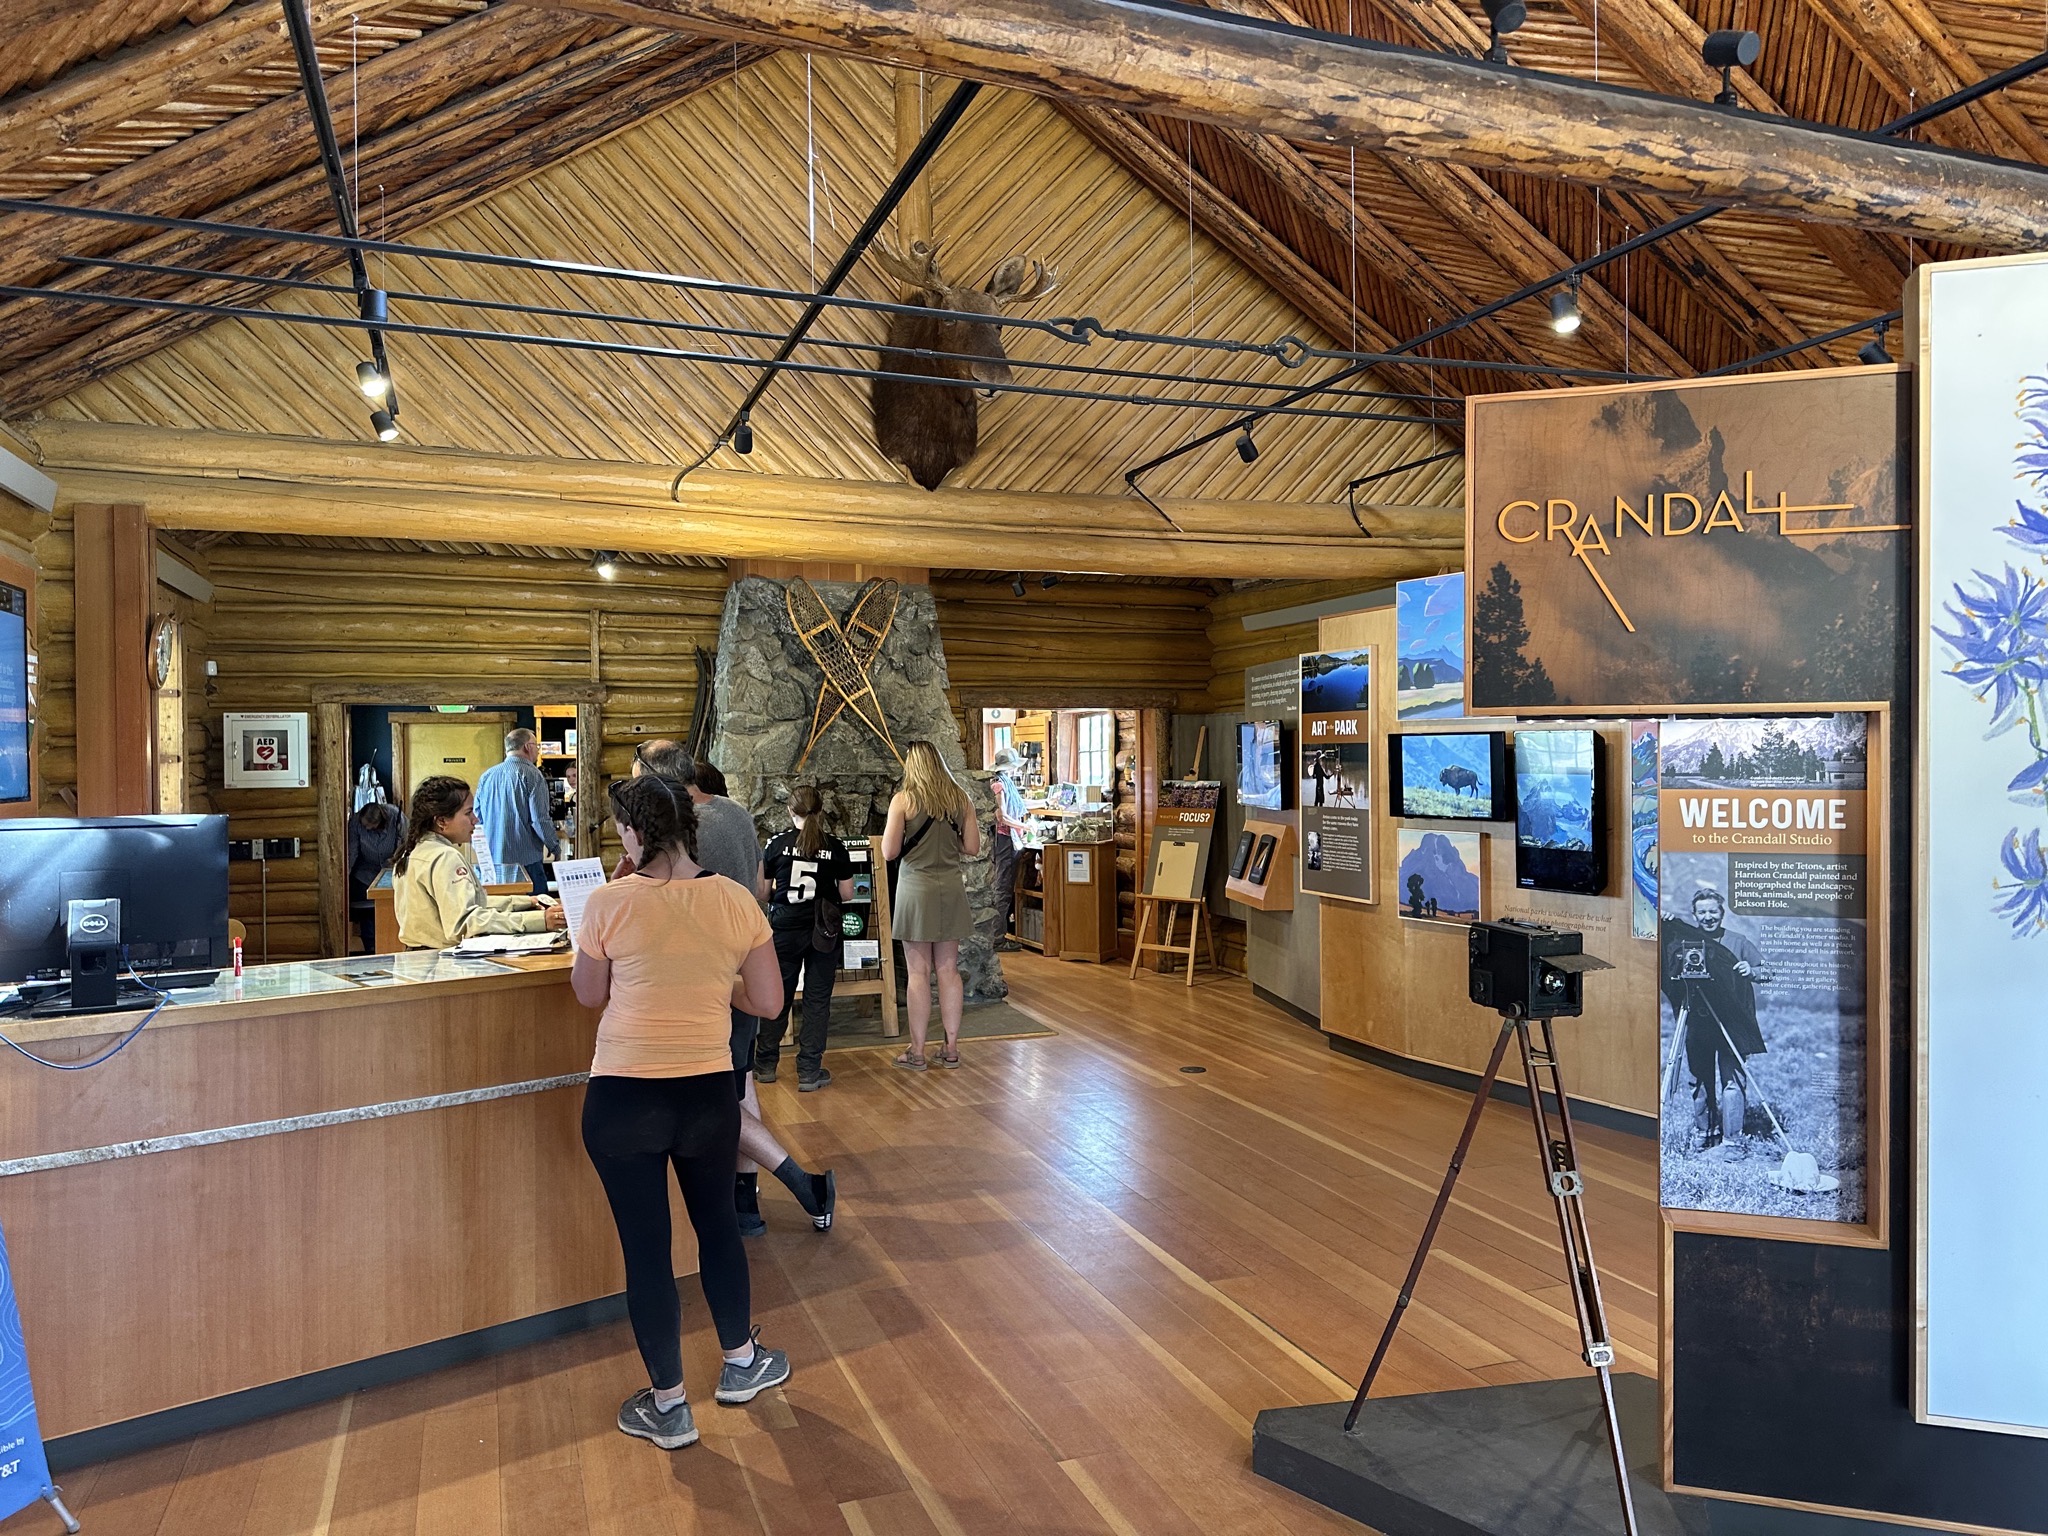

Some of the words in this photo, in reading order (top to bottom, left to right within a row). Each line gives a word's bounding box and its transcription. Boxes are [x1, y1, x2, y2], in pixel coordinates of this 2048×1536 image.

[1497, 470, 1912, 632] CRANDALL
[1312, 721, 1327, 736] ART
[1335, 719, 1358, 735] PARK
[1179, 812, 1210, 822] FOCUS?
[1679, 798, 1846, 830] WELCOME
[842, 840, 870, 848] grams
[1692, 834, 1706, 843] to
[1708, 833, 1729, 843] the
[1732, 833, 1786, 844] Crandall
[1790, 834, 1832, 845] Studio
[783, 846, 790, 856] J.
[1735, 861, 1768, 870] Inspired
[1770, 862, 1780, 871] by
[1796, 862, 1824, 871] Tetons,
[787, 860, 818, 904] 5
[1809, 873, 1840, 883] painted
[1735, 880, 1791, 891] photographed
[1808, 882, 1854, 891] landscapes,
[1735, 890, 1761, 899] plants,
[1814, 892, 1842, 901] people
[1734, 900, 1766, 908] Jackson
[1504, 905, 1529, 914] National
[1530, 908, 1546, 916] parks
[1586, 913, 1594, 921] be
[1595, 914, 1612, 923] what
[1551, 920, 1594, 931] photographers
[0, 1442, 15, 1454] ible
[16, 1436, 24, 1446] by
